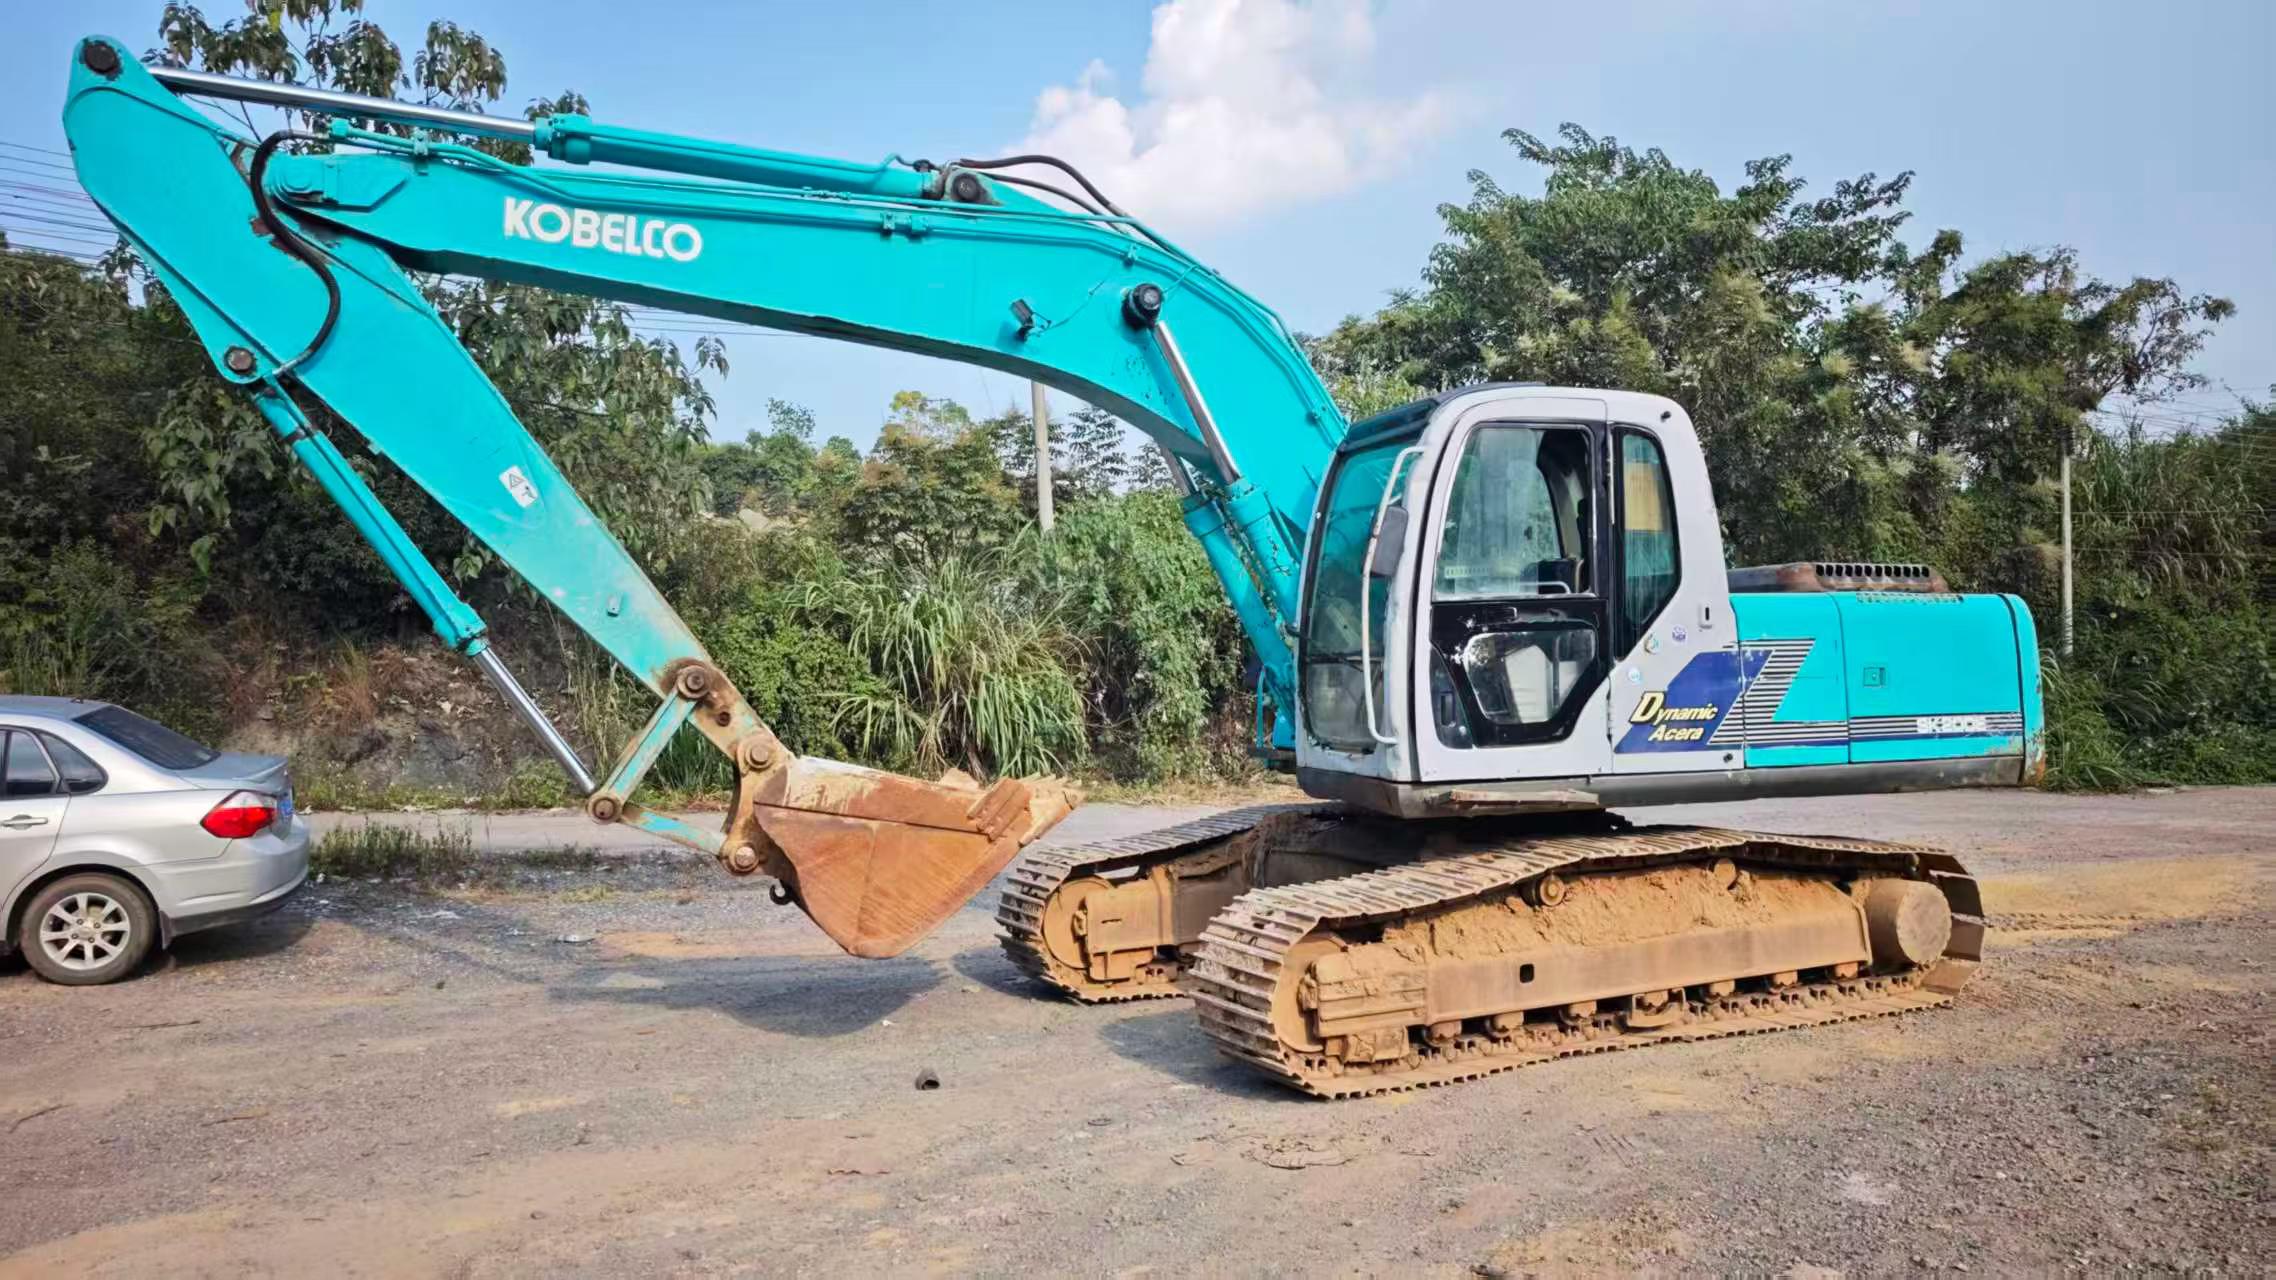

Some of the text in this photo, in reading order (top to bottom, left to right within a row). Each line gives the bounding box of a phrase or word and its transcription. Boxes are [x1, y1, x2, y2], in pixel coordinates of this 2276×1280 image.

[504, 196, 703, 262] KOBELCO
[1630, 691, 1718, 726] Dynamic
[1647, 724, 1704, 742] Acera
